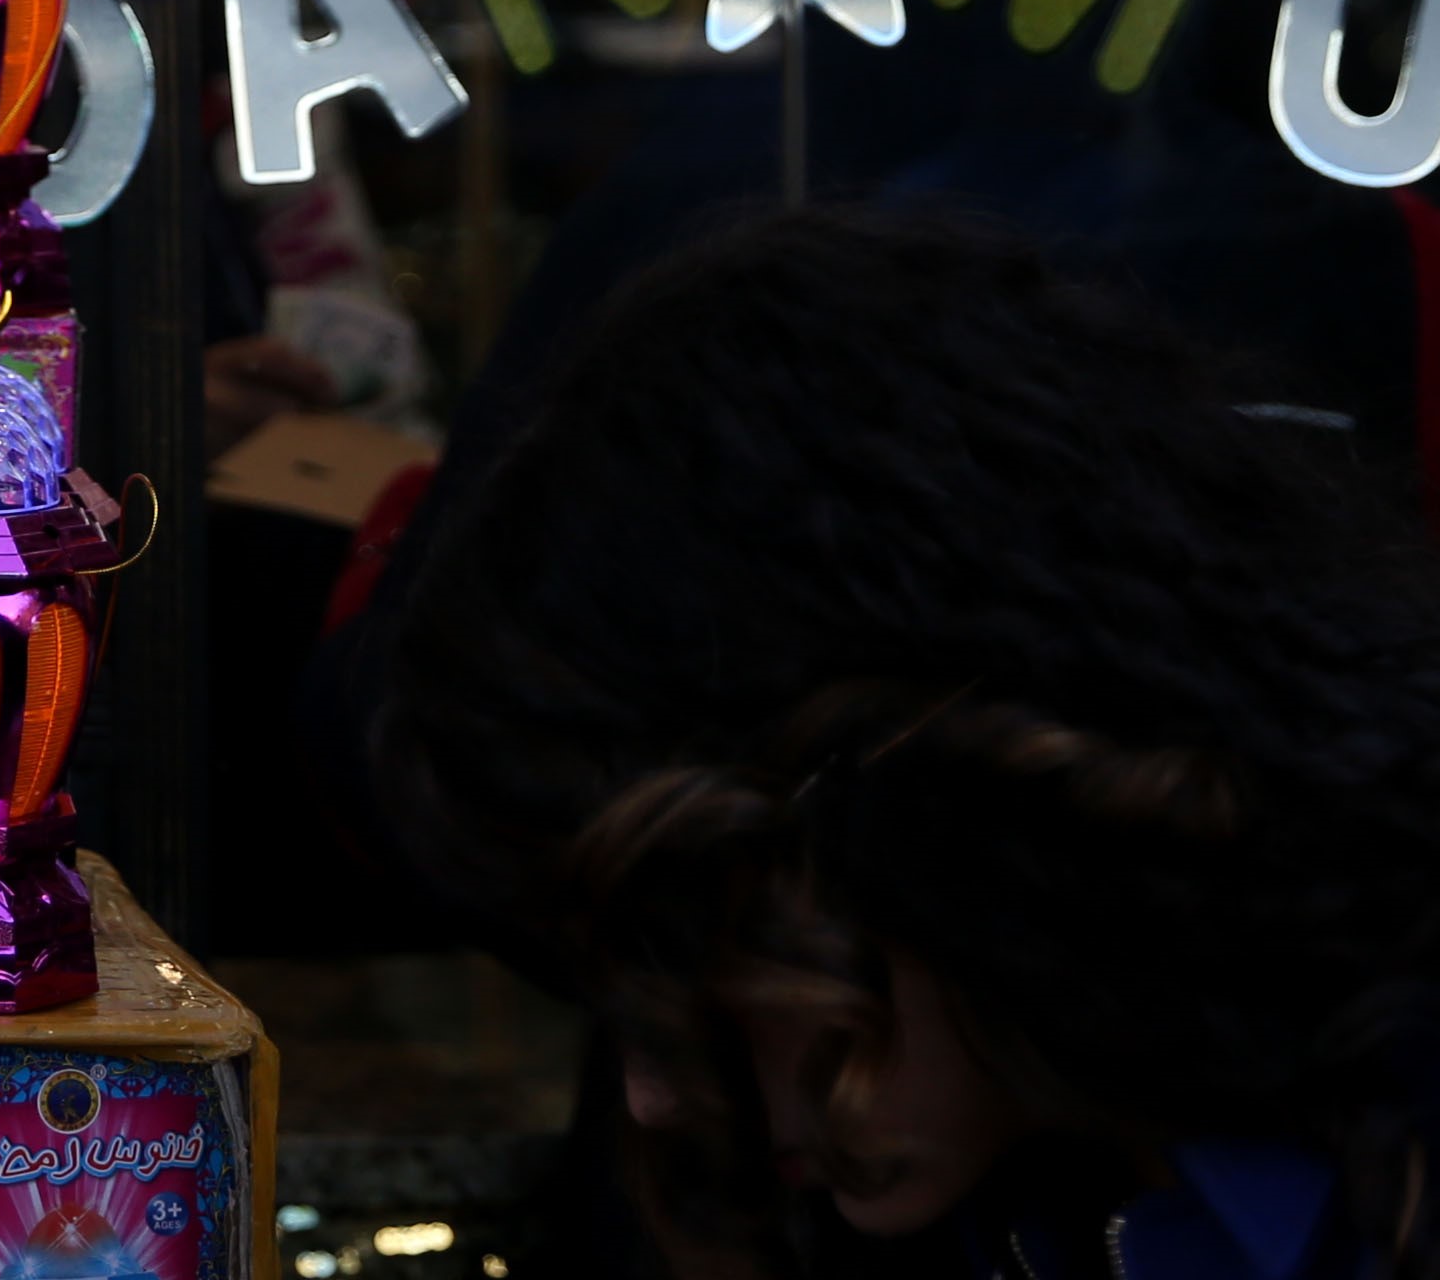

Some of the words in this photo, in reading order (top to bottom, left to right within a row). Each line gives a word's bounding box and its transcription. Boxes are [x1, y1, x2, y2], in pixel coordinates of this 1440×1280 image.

[82, 1122, 205, 1182] فانوس
[152, 1200, 183, 1221] 3+
[153, 1221, 182, 1230] AGES
